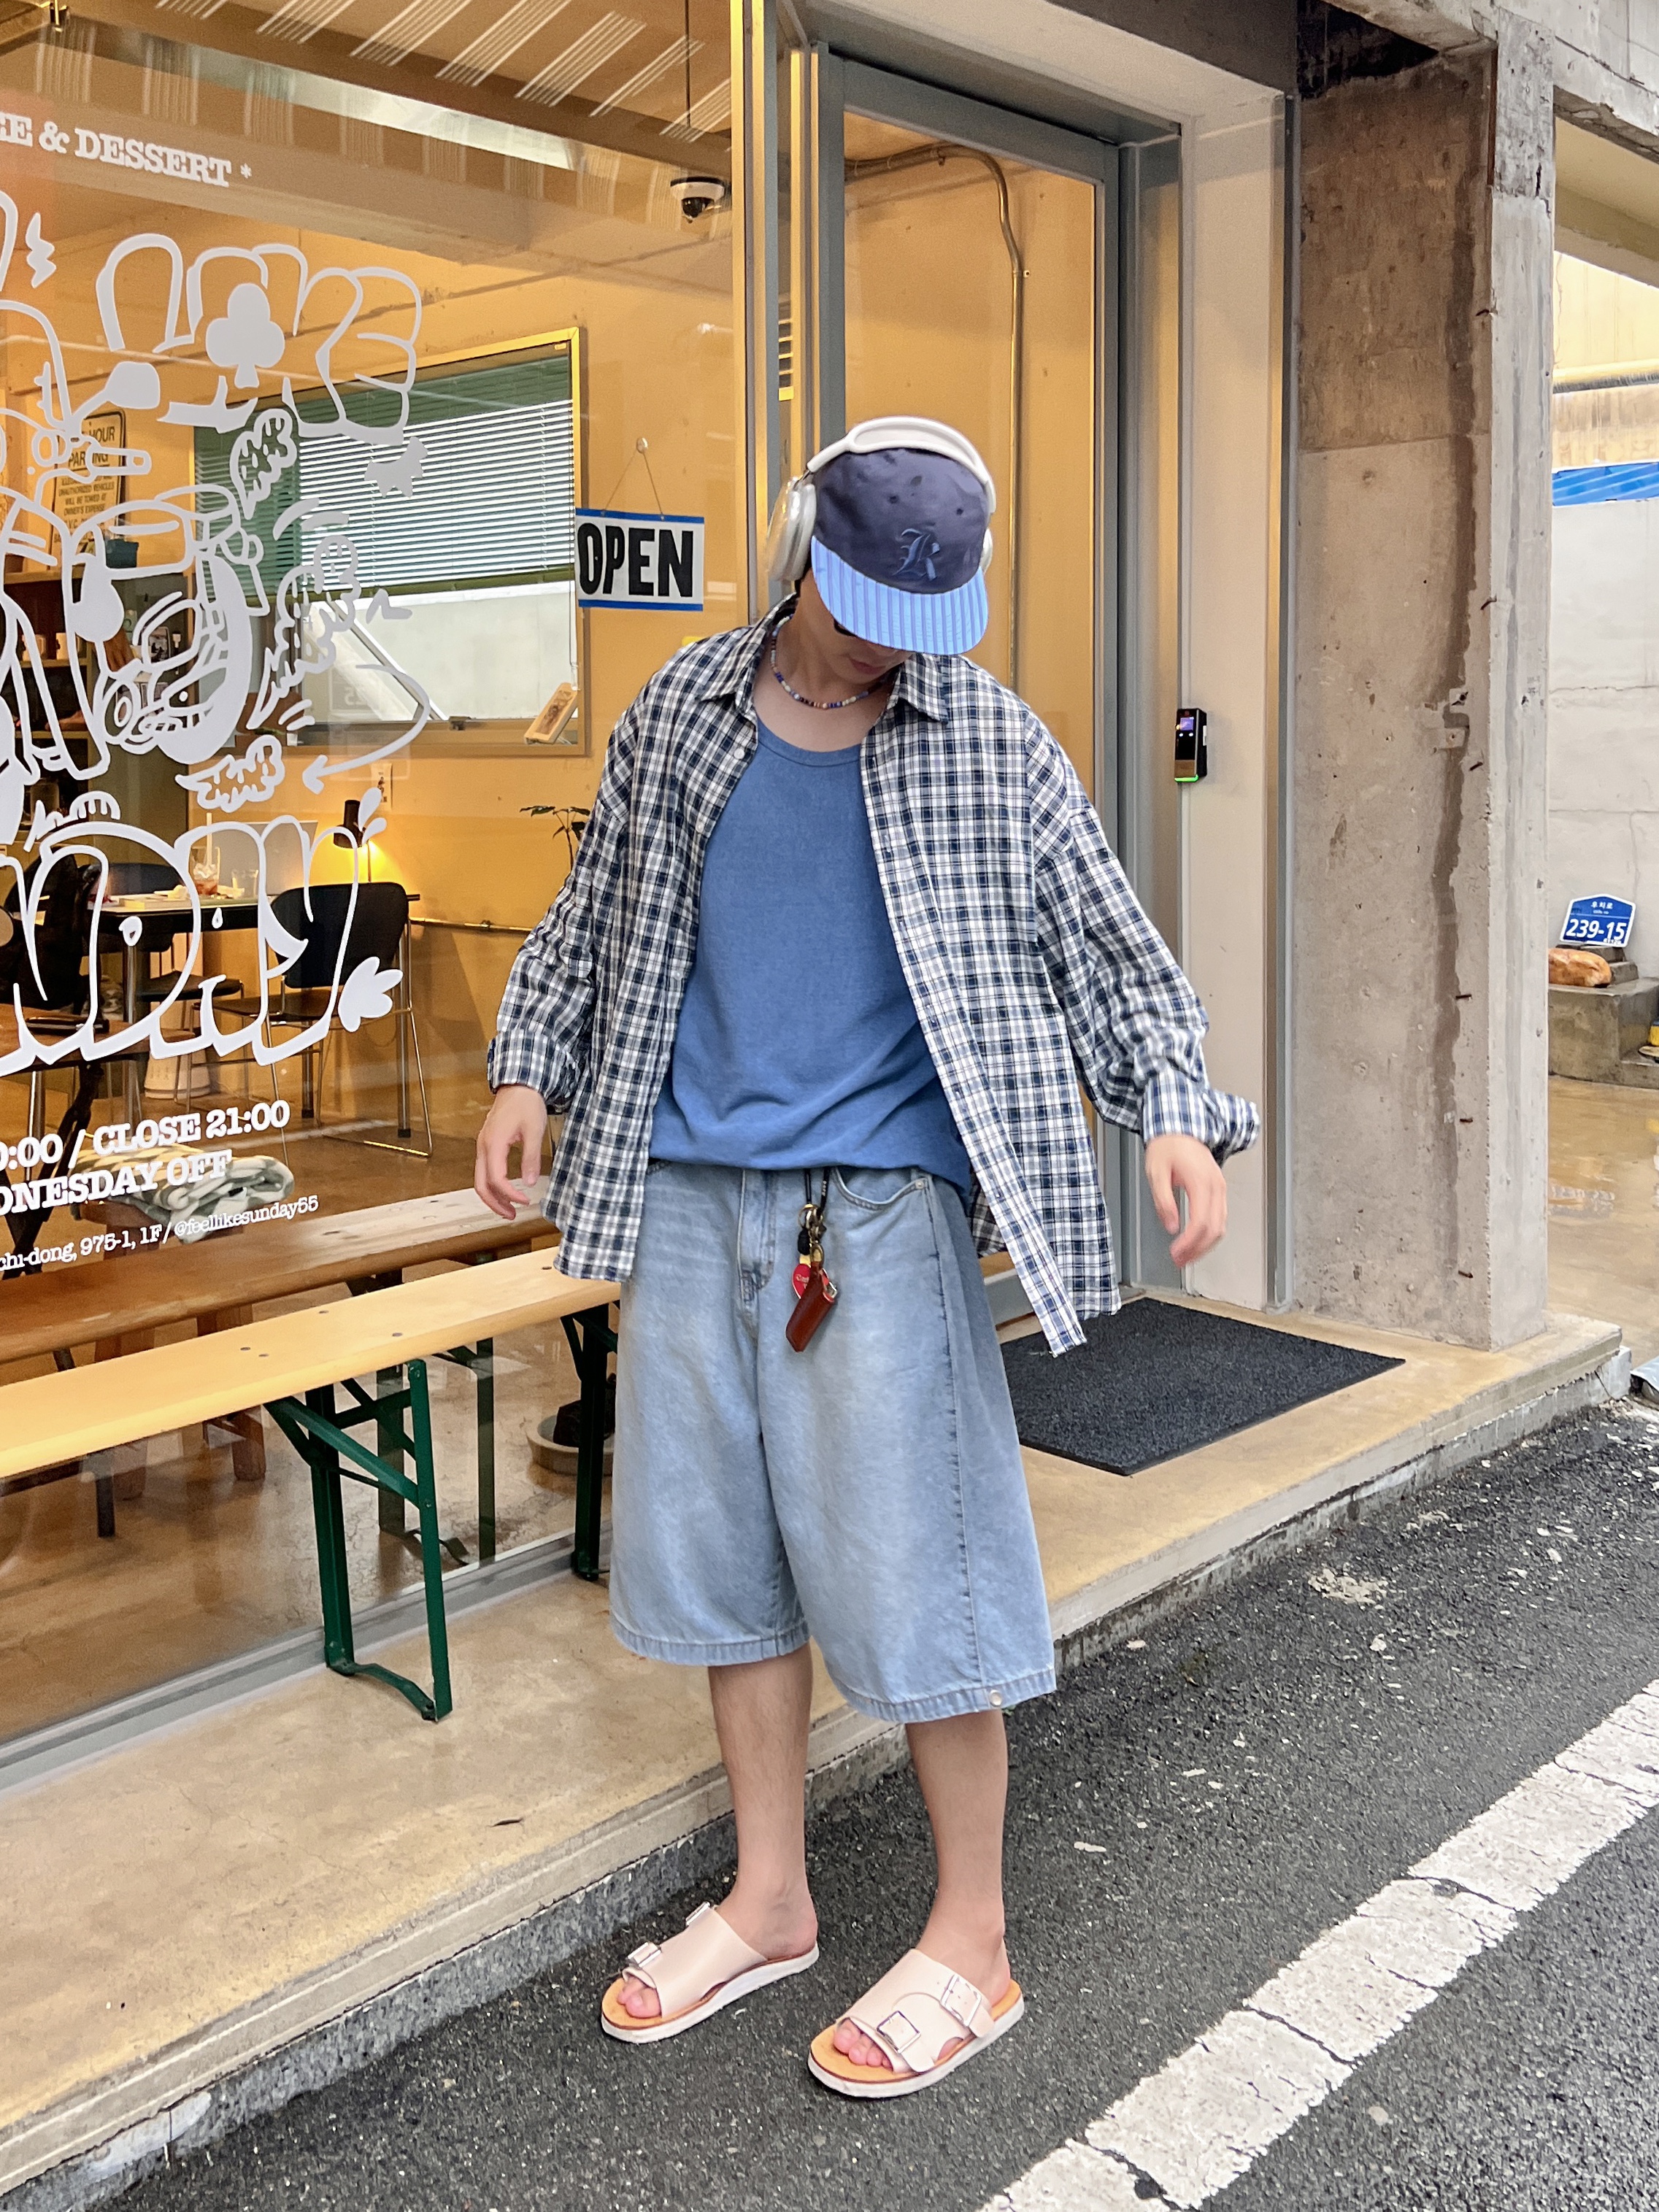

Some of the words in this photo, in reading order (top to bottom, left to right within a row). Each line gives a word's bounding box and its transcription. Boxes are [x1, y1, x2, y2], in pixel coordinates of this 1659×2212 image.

[39, 120, 70, 154] &
[74, 128, 231, 188] DESSERT
[69, 451, 108, 468] PARING
[577, 522, 693, 598] OPEN
[1566, 919, 1627, 941] 239-15
[93, 1112, 201, 1155] CLOSE
[206, 1100, 290, 1139] 21:00
[166, 1149, 233, 1187] OFF
[80, 1230, 136, 1256] 975-1,
[174, 1195, 319, 1237] @feellikesunday55
